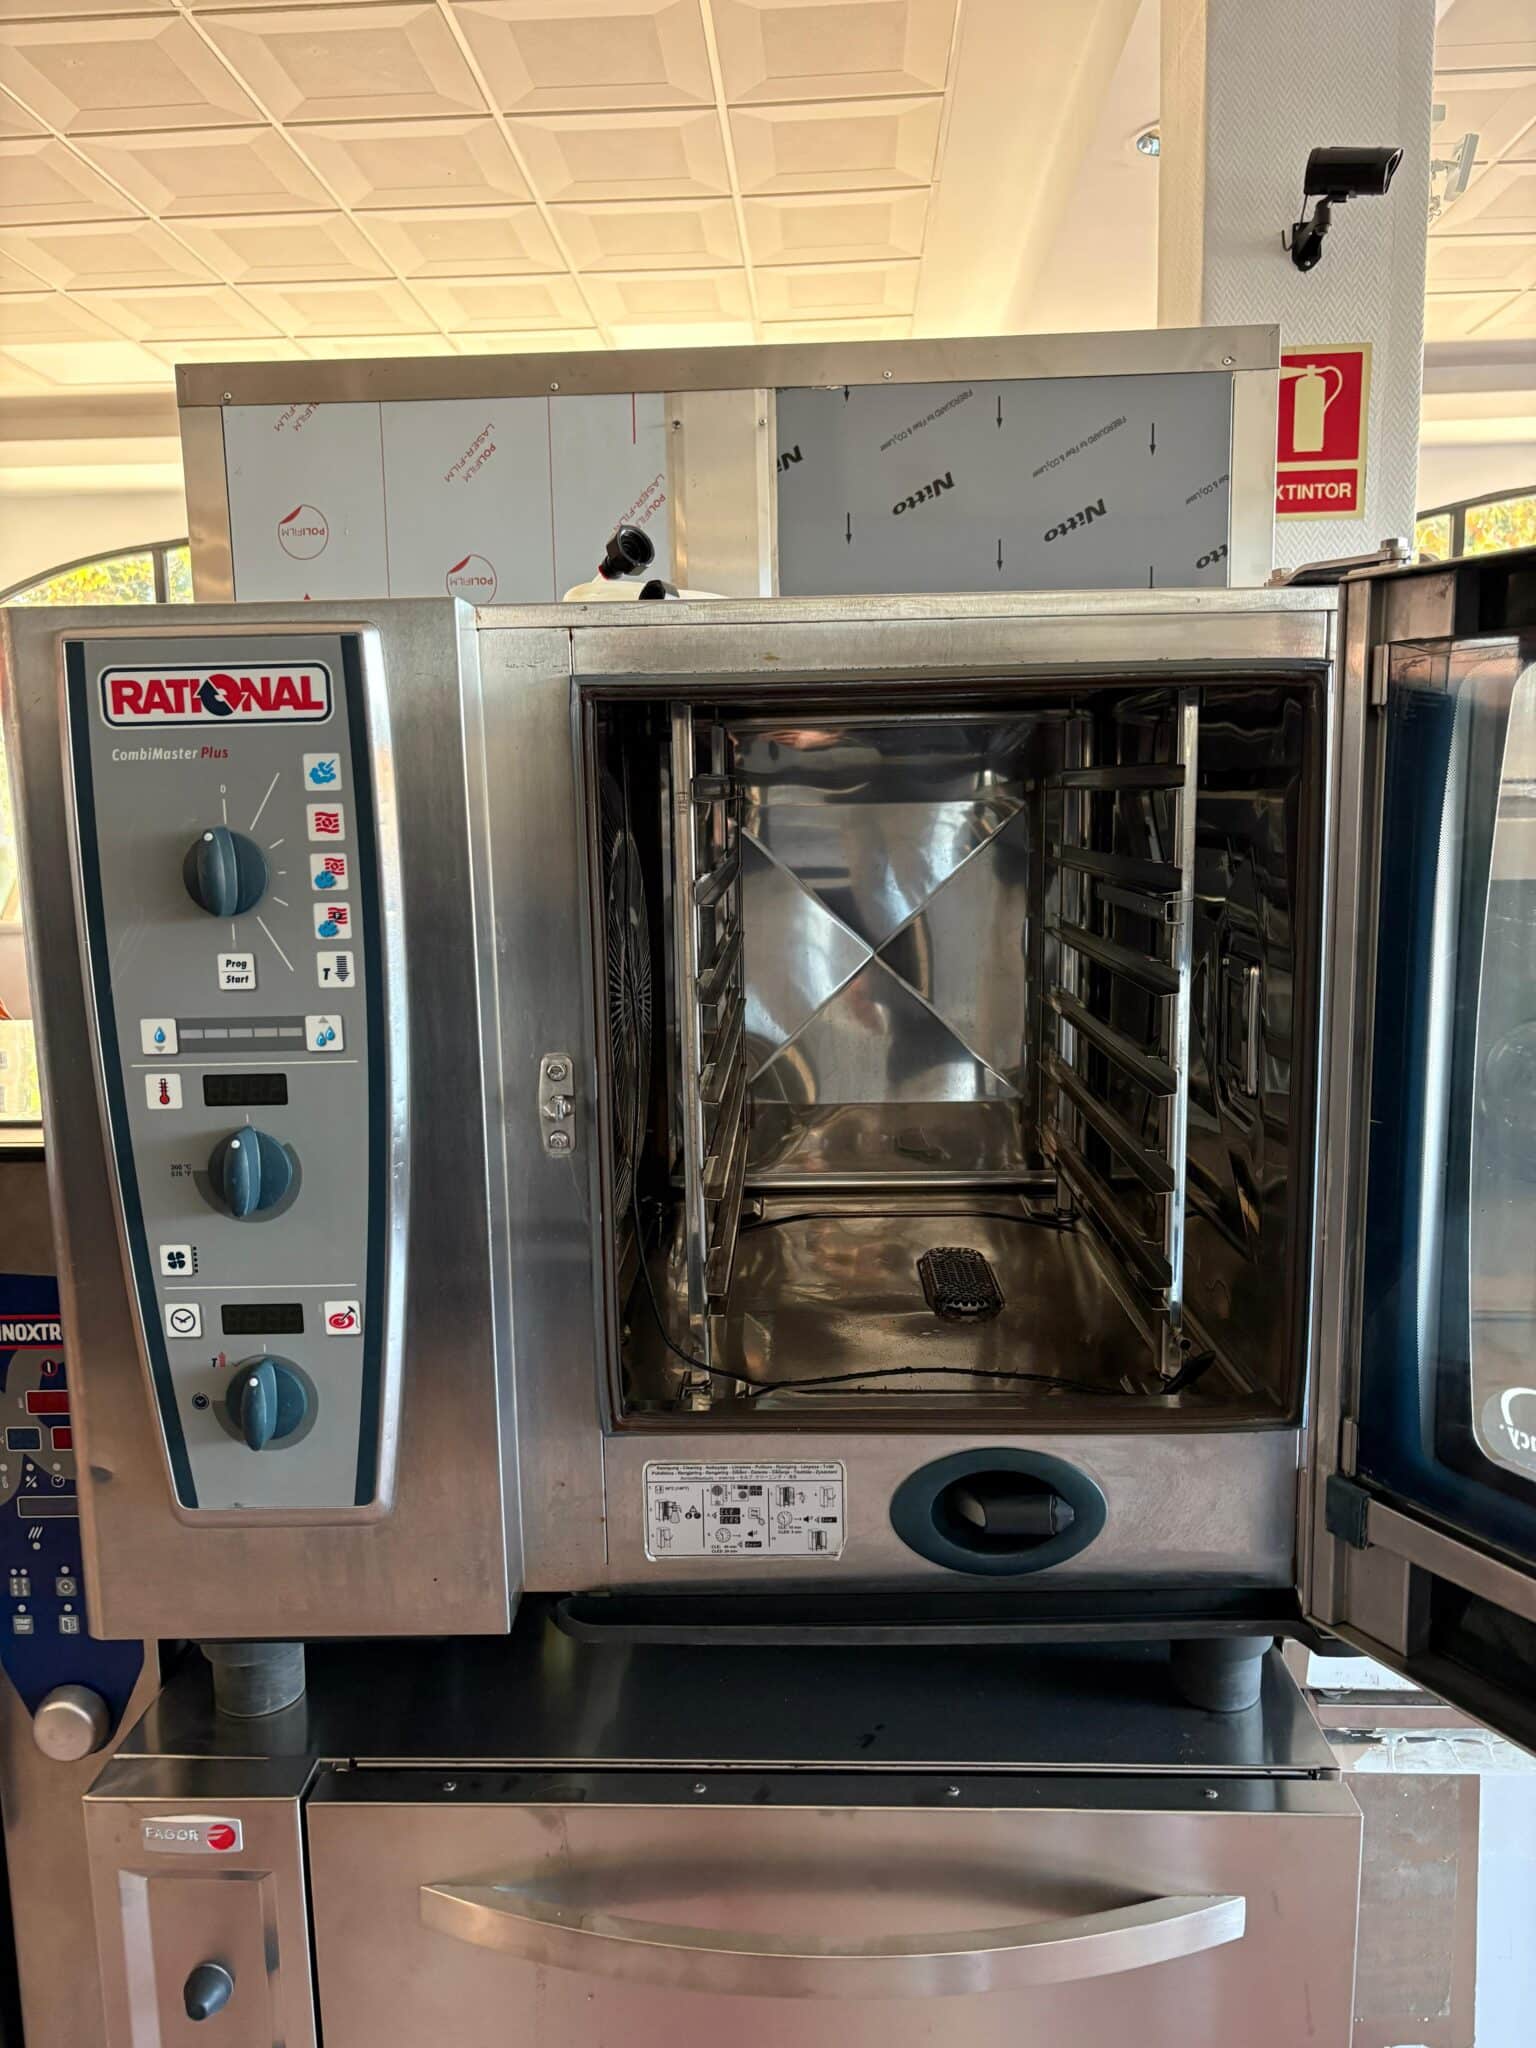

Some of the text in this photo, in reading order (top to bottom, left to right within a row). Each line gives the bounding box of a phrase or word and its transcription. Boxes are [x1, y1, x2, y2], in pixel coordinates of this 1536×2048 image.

[444, 423, 495, 483] LASER-FILM
[462, 443, 496, 483] POLIFILM
[616, 473, 664, 529] LASER-FIL
[892, 471, 955, 516] Nitto
[1276, 482, 1352, 500] XTINTOR
[635, 494, 666, 527] POLIFIL
[1043, 498, 1107, 543] Nitto
[281, 526, 325, 537] POLIFILM
[1196, 544, 1228, 569] tto
[449, 576, 493, 588] POLIFILM
[110, 674, 325, 716] RATIONAL
[112, 747, 229, 761] CombiMaster Plus
[225, 959, 248, 970] Prog
[322, 968, 331, 980] T
[225, 975, 249, 984] Start
[145, 1827, 199, 1841] FAGOR
